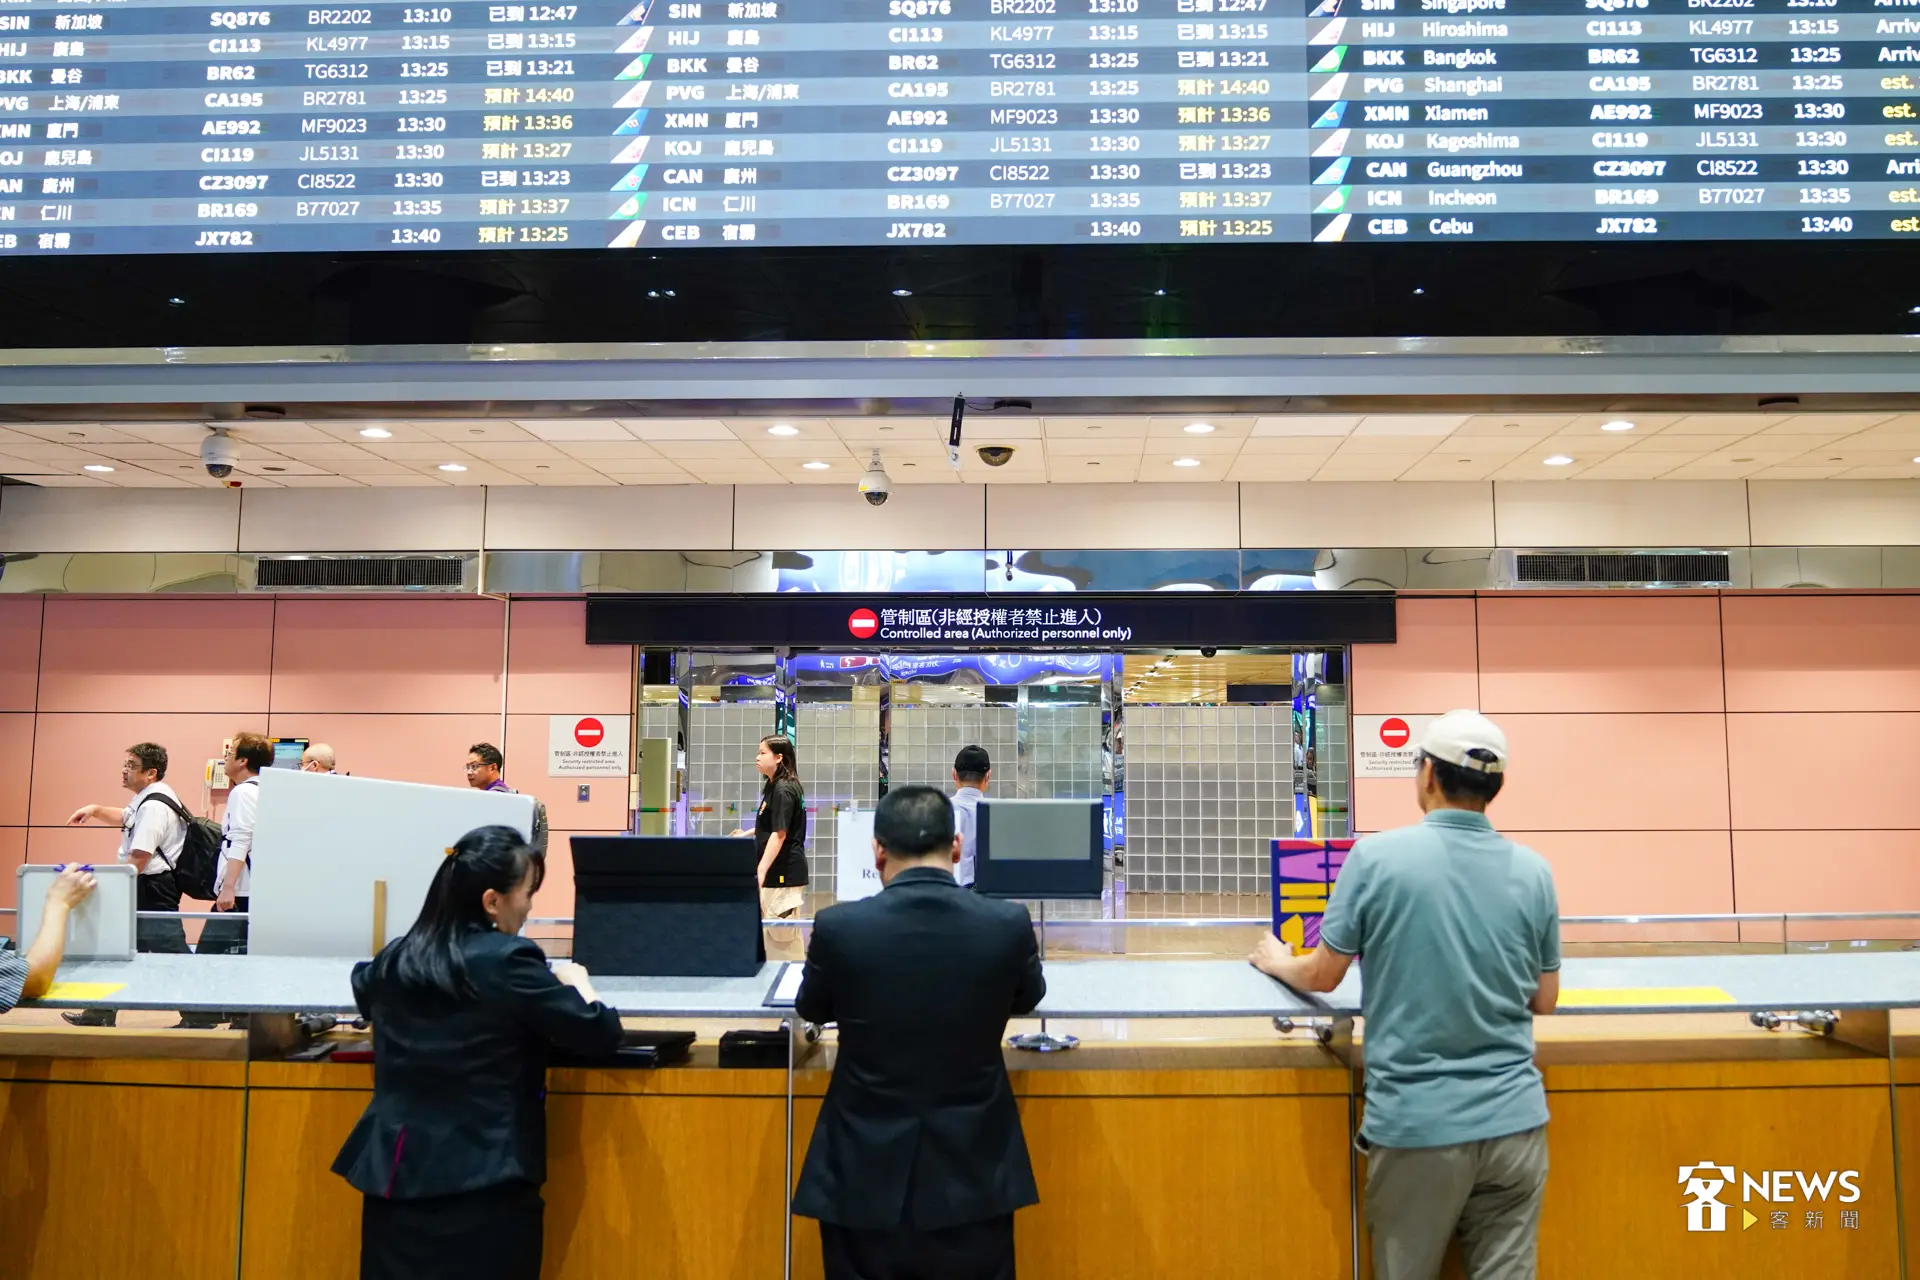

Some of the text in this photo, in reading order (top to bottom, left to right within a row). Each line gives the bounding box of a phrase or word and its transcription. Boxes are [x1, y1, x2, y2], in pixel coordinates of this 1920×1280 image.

[0, 17, 29, 29] SIN
[211, 12, 270, 28] SQ876
[309, 10, 370, 24] BR2202
[404, 9, 451, 22] 13:10
[490, 6, 524, 21] 已到
[530, 6, 577, 20] 12:47
[669, 4, 701, 18] SIN
[669, 24, 1267, 45] HIJ CI113 KL4977 13:15 13:15
[1363, 20, 1839, 37] HIJ Hiroshima KL4977 13:15
[209, 39, 260, 53] CI113
[307, 37, 368, 50] KL4977
[402, 36, 449, 49] 13:15
[488, 34, 523, 49] 已到
[529, 34, 575, 47] 13:15
[668, 52, 1268, 72] BKK BR62 TG6312 13:25 13:21
[1364, 48, 1840, 68] BKK Bangkok TG6312 13:25
[207, 61, 574, 80] BR62 TG6312 13:25 已到 13:21
[667, 85, 704, 100] PVG
[888, 83, 948, 97] CA195
[991, 82, 1055, 96] BR2781
[1090, 81, 1138, 95] 13:25
[1220, 80, 1269, 94] 14:40
[1364, 75, 1914, 96] PVG Shanghai BR2781 13:25 est.
[205, 93, 262, 107] CA195
[304, 92, 365, 105] BR2781
[399, 90, 446, 104] 13:25
[485, 88, 520, 103] 預計
[526, 88, 573, 102] 14:40
[665, 108, 1270, 127] XMN AE992 MF9023 13:30 13:36
[1365, 104, 1916, 120] XMN Xiamen MF9023 13:30 est.
[202, 116, 572, 134] AE992 MF9023 13:30 預計 13:36
[665, 136, 1270, 155] KOJ CI119 JL5131 13:30 13:27
[1366, 131, 1918, 152] KOJ Kagoshima JL5131 13:30 est.
[202, 148, 254, 162] CI119
[300, 146, 358, 160] JL5131
[396, 145, 444, 159] 13:30
[482, 143, 518, 159] 預計
[524, 143, 571, 157] 13:27
[664, 164, 1271, 183] CAN CZ3097 CI8522 13:30 13:23
[1367, 160, 1848, 180] CAN Guangzhou CI8522 13:30
[200, 176, 266, 189] CZ3097
[298, 174, 355, 188] CI8522
[395, 173, 442, 187] 13:30
[482, 171, 516, 186] 已到
[523, 171, 569, 185] 13:23
[663, 197, 696, 211] ICN
[888, 195, 949, 209] BR169
[991, 194, 1055, 208] B77027
[1091, 193, 1140, 207] 13:35
[1223, 192, 1271, 207] 13:37
[1368, 188, 1850, 205] ICN Incheon B77027 13:35
[198, 203, 257, 217] BR169
[297, 202, 359, 216] B77027
[393, 201, 441, 215] 13:35
[480, 199, 516, 214] 預計
[522, 199, 569, 213] 13:37
[662, 221, 1272, 240] CEB JX782 13:40 13:25
[1368, 217, 1852, 234] CEB Cebu 13:40
[196, 232, 252, 245] JX782
[392, 229, 440, 243] 13:40
[479, 227, 514, 242] 預計
[520, 227, 567, 241] 13:25
[881, 608, 1102, 626] 管制區(非經授權者禁止進入)
[880, 627, 1131, 641] Controlled area (Authorized personnel only)
